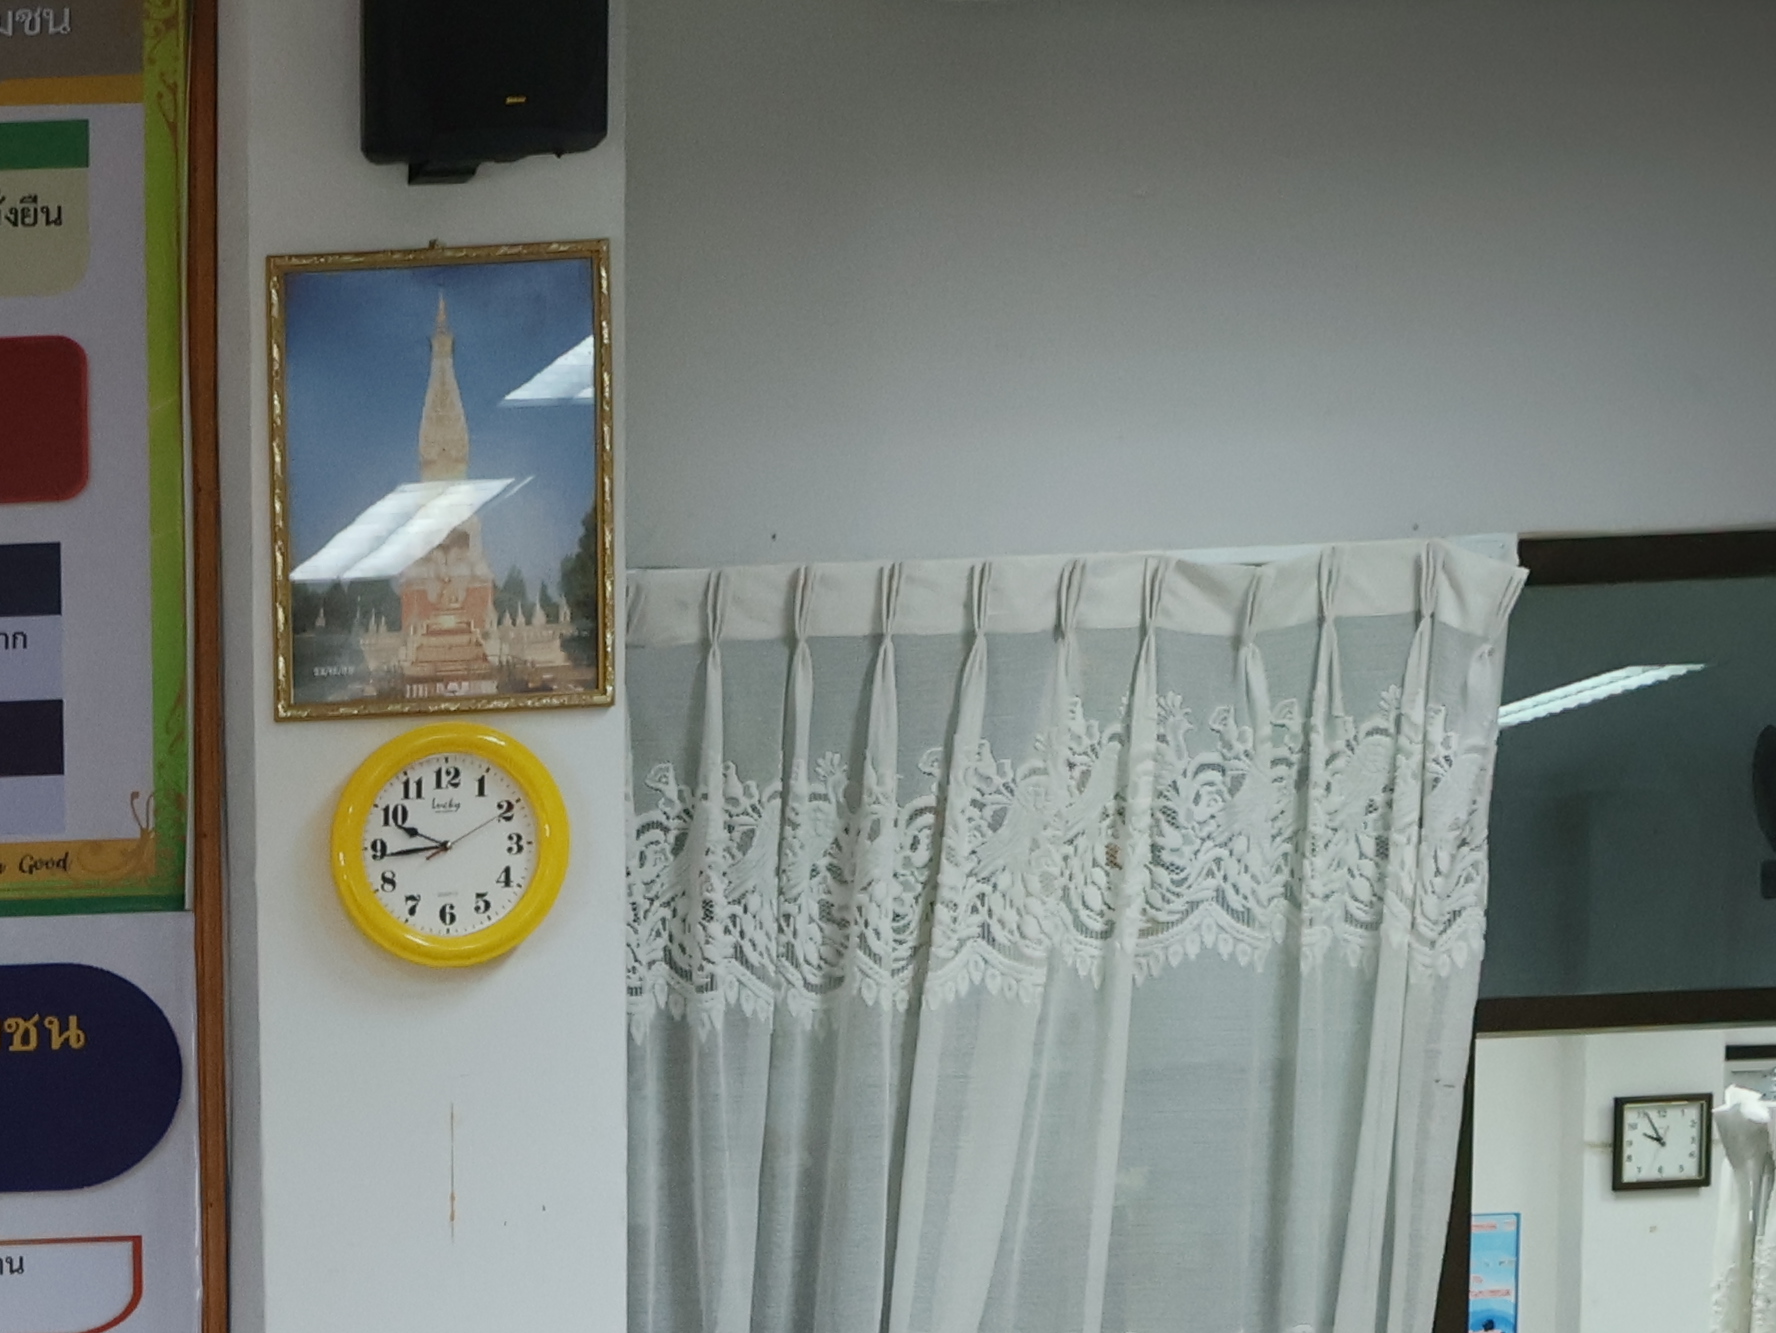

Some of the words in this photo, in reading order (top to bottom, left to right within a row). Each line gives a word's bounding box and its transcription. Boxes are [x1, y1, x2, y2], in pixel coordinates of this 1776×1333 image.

[401, 776, 425, 801] 11
[433, 765, 461, 790] 12
[474, 775, 488, 798] 1
[381, 803, 409, 827] 10
[496, 799, 515, 823] 2
[370, 838, 388, 861] 9
[506, 832, 525, 855] 3
[380, 870, 397, 893] 8
[496, 865, 514, 888] 4
[404, 894, 422, 917] 7
[438, 903, 457, 926] 6
[473, 892, 492, 914] 5
